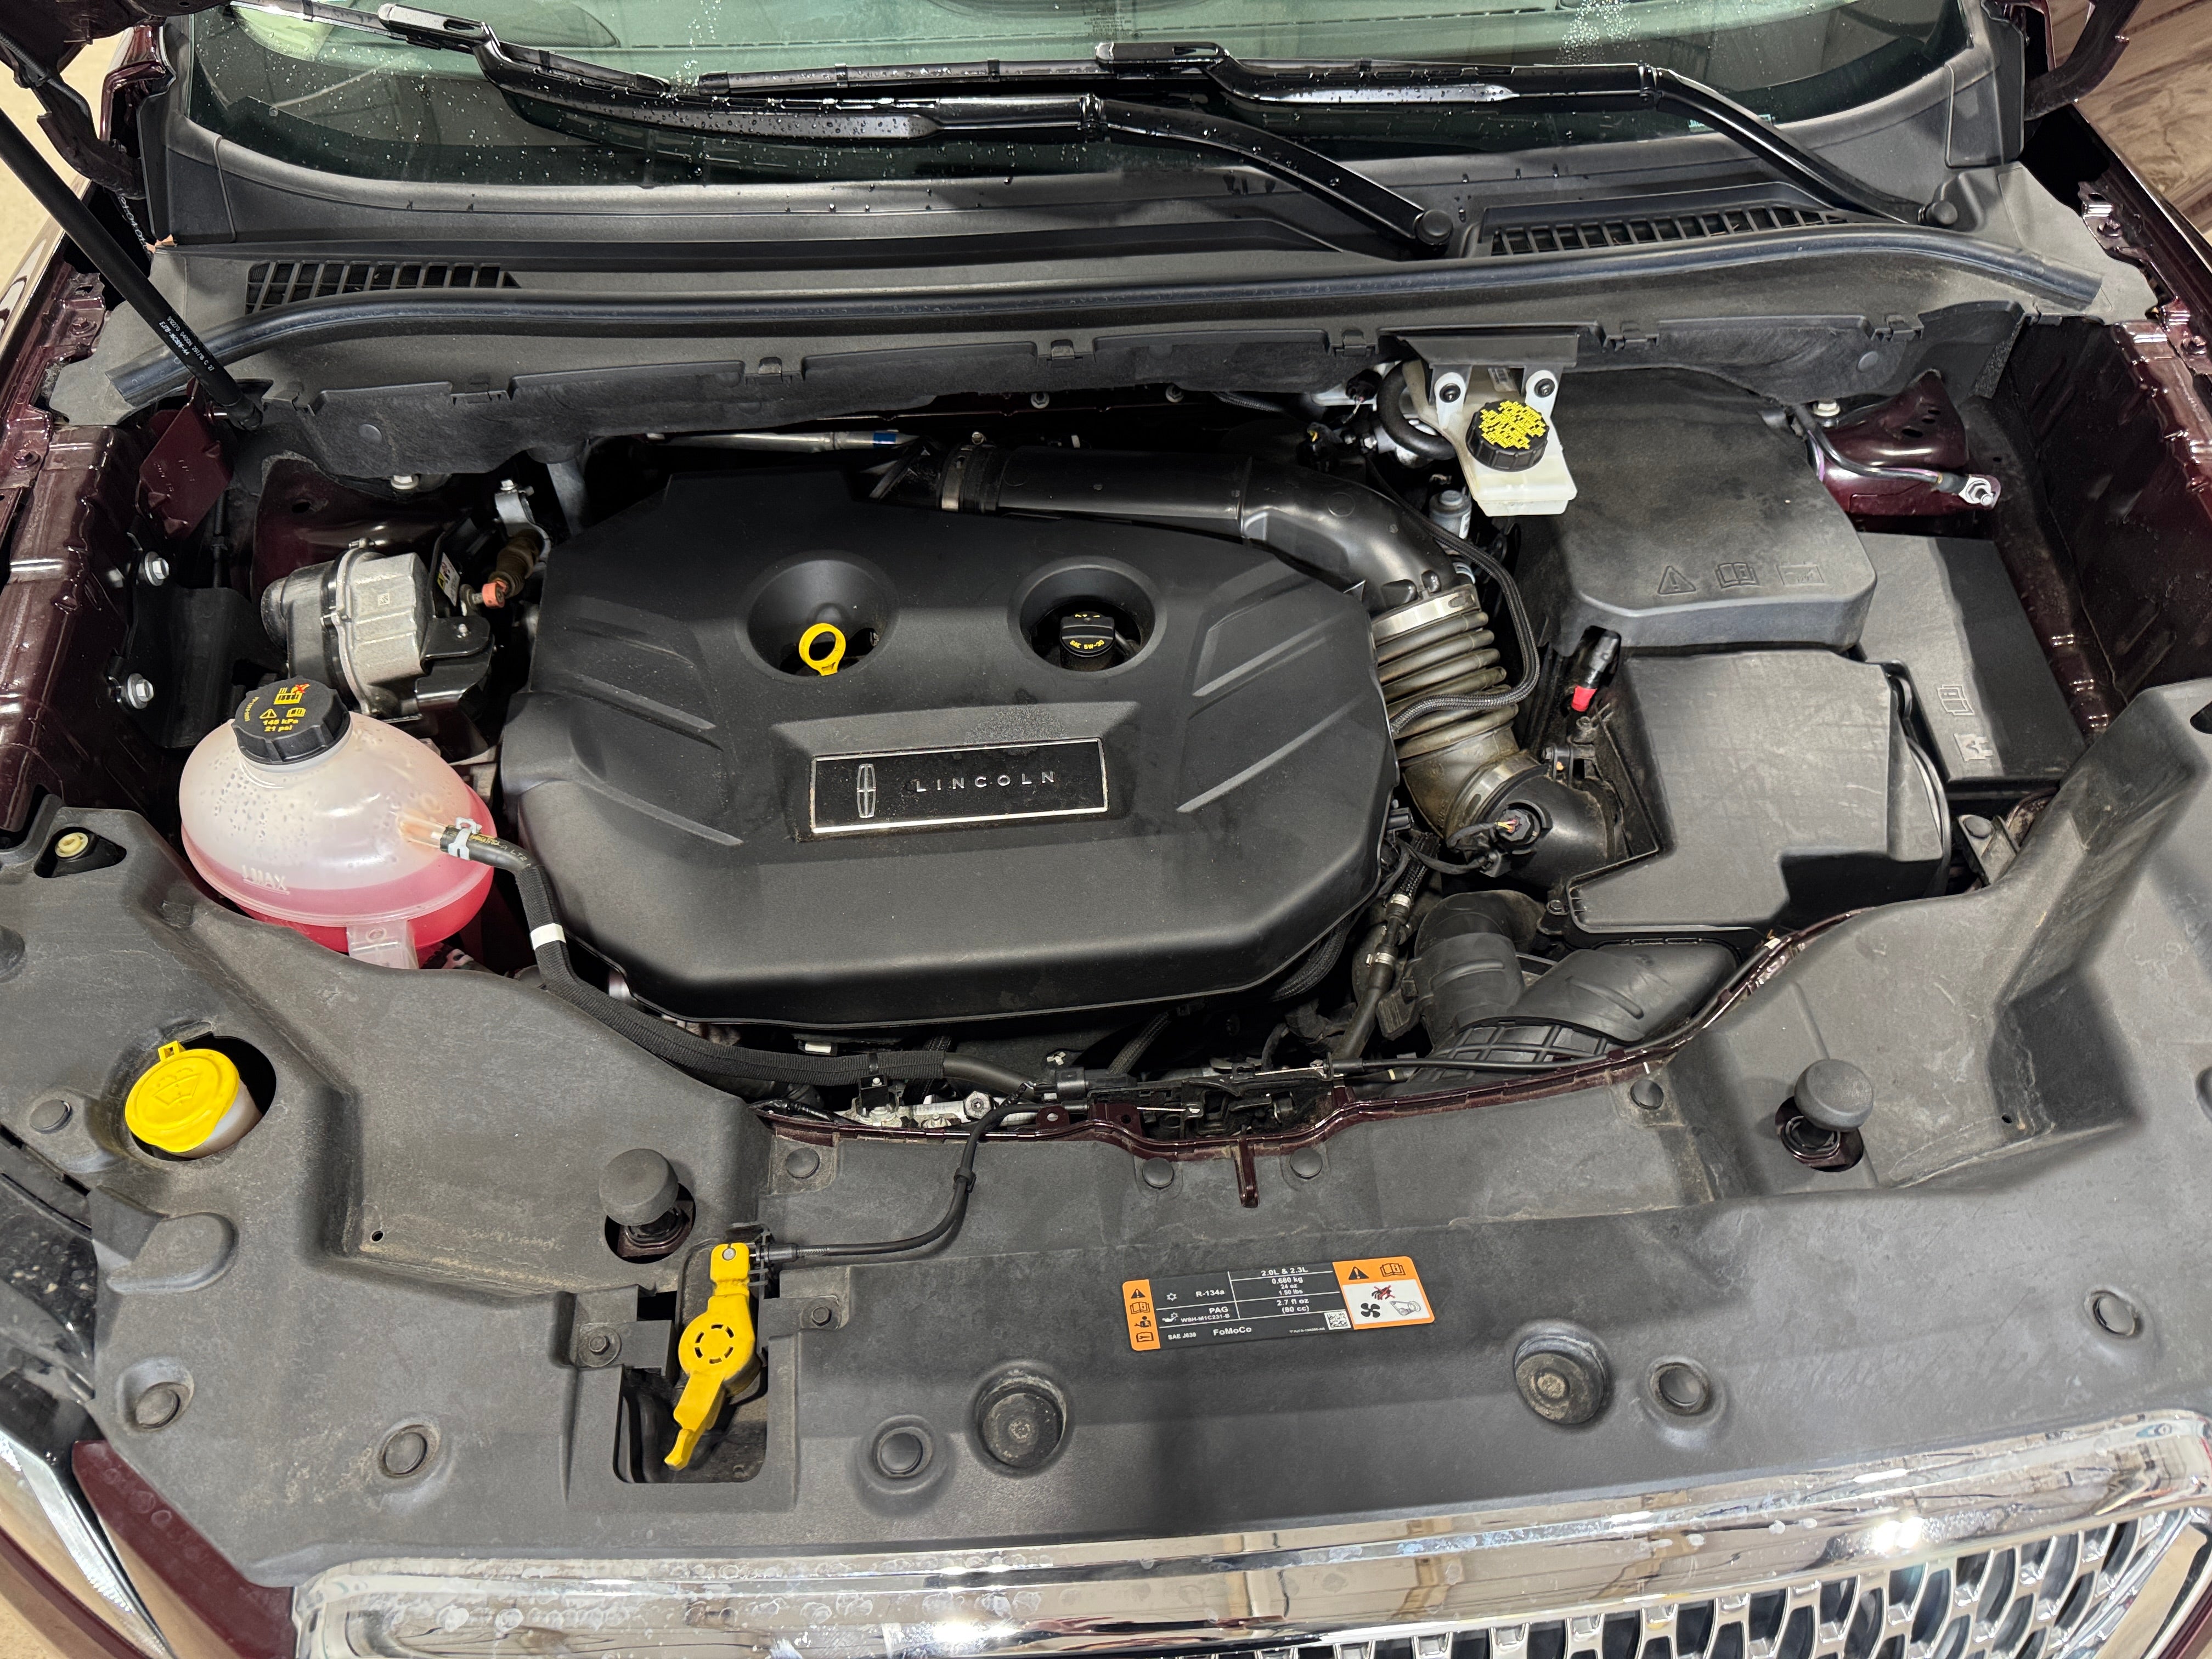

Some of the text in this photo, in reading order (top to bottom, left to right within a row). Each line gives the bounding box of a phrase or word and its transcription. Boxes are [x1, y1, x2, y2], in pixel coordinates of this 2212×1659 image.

[1069, 640, 1105, 650] SAE 5W-30
[915, 771, 1056, 793] LINCOLN
[250, 867, 287, 891] MAX
[1195, 1289, 1225, 1297] R-134a
[1213, 1325, 1252, 1336] FoMoCo
